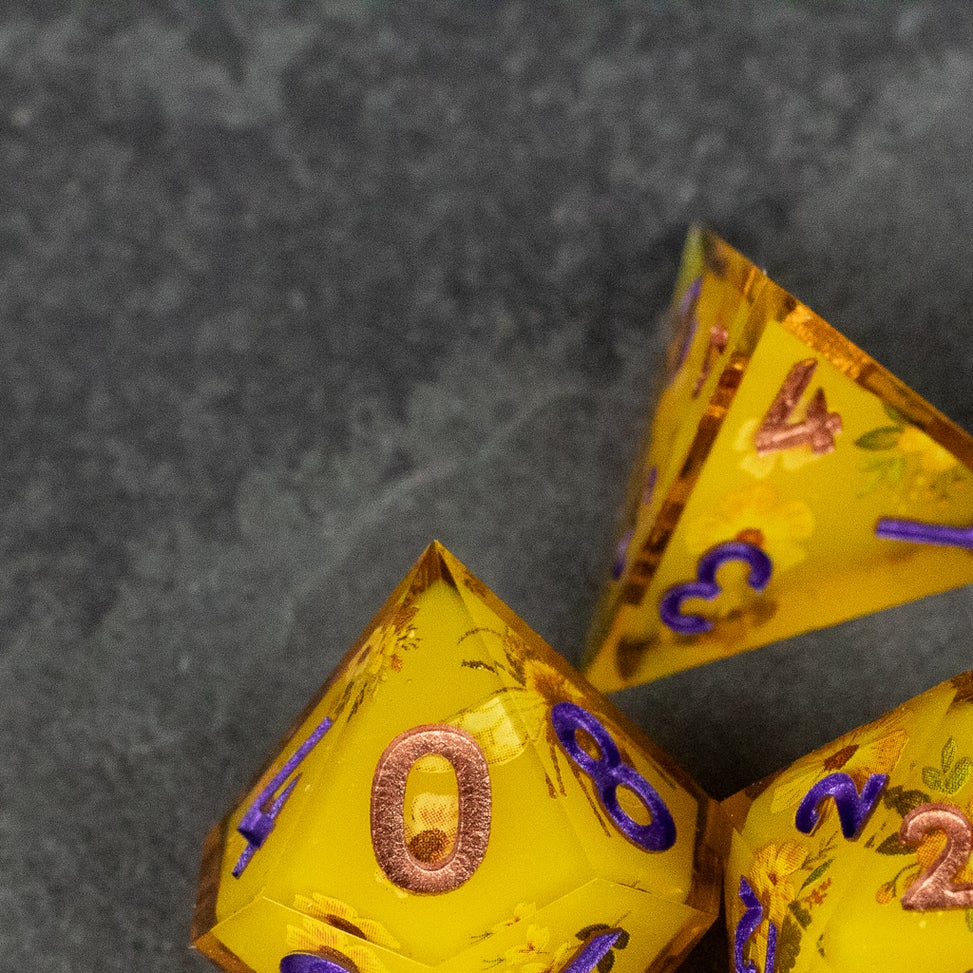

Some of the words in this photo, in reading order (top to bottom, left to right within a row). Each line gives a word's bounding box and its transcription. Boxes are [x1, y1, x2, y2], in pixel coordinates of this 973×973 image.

[754, 357, 843, 457] 4
[659, 539, 773, 635] 3
[231, 716, 333, 878] 4
[370, 723, 493, 897] 0
[551, 701, 678, 854] 8
[795, 771, 891, 841] 2
